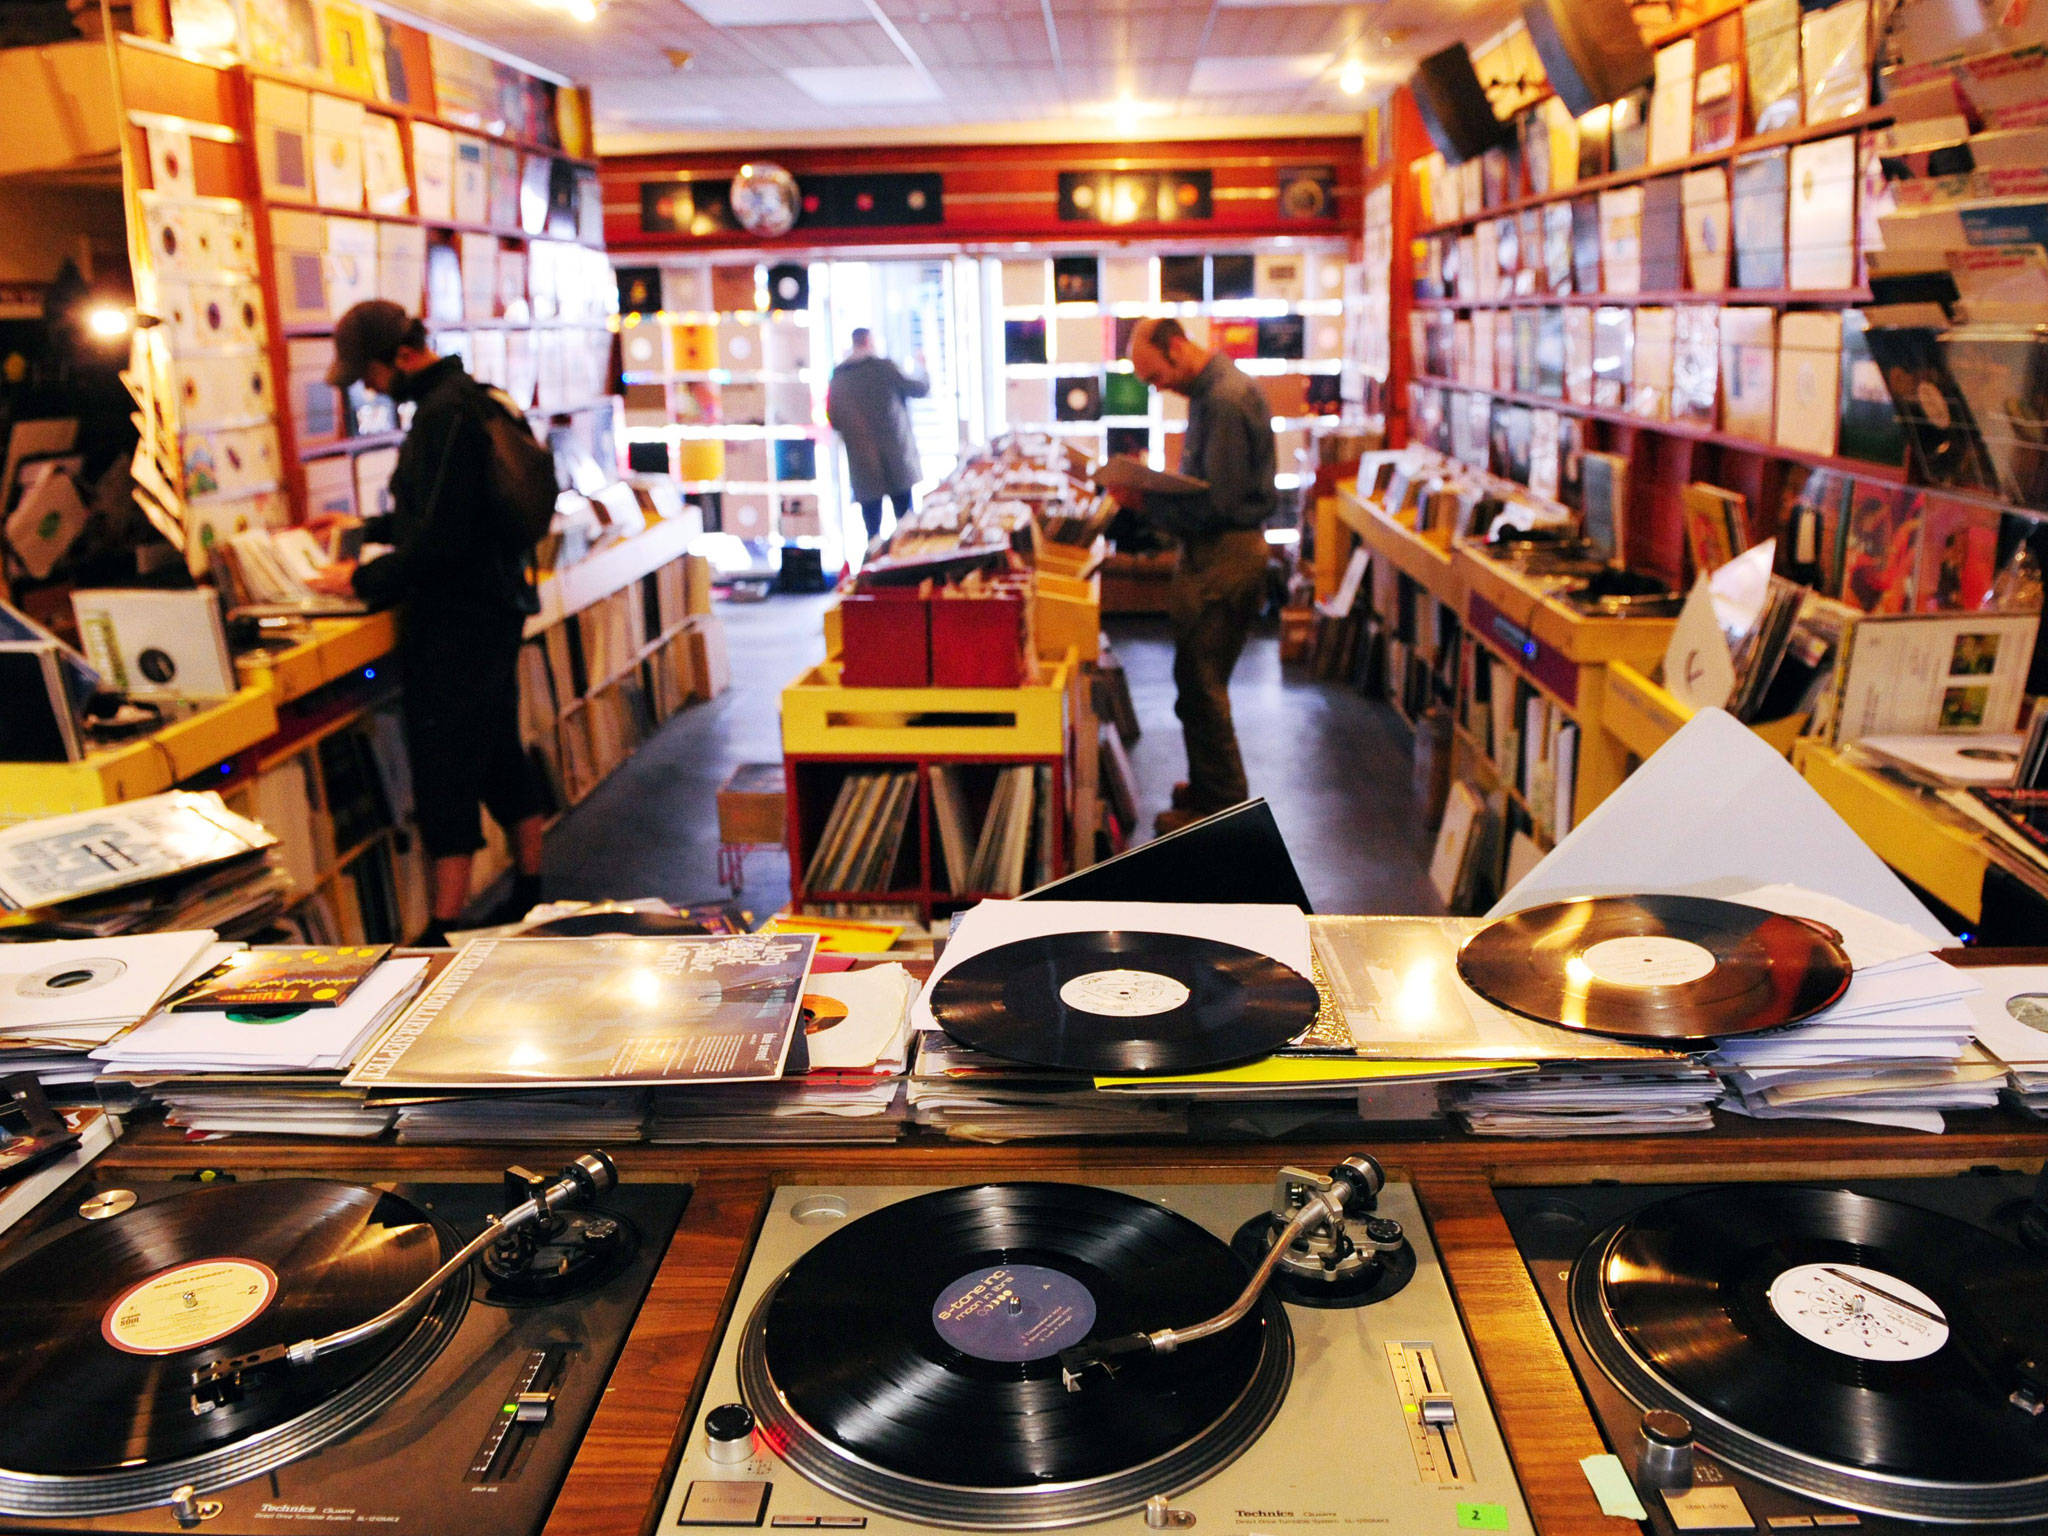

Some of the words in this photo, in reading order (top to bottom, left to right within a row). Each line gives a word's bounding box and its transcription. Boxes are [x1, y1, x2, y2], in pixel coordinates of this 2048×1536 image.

[393, 994, 453, 1037] COLLIER
[361, 1036, 417, 1080] SEPTET
[247, 1285, 259, 1295] 2
[261, 1503, 316, 1513] Technics
[1235, 1510, 1294, 1518] Technics
[1471, 1510, 1481, 1521] 2
